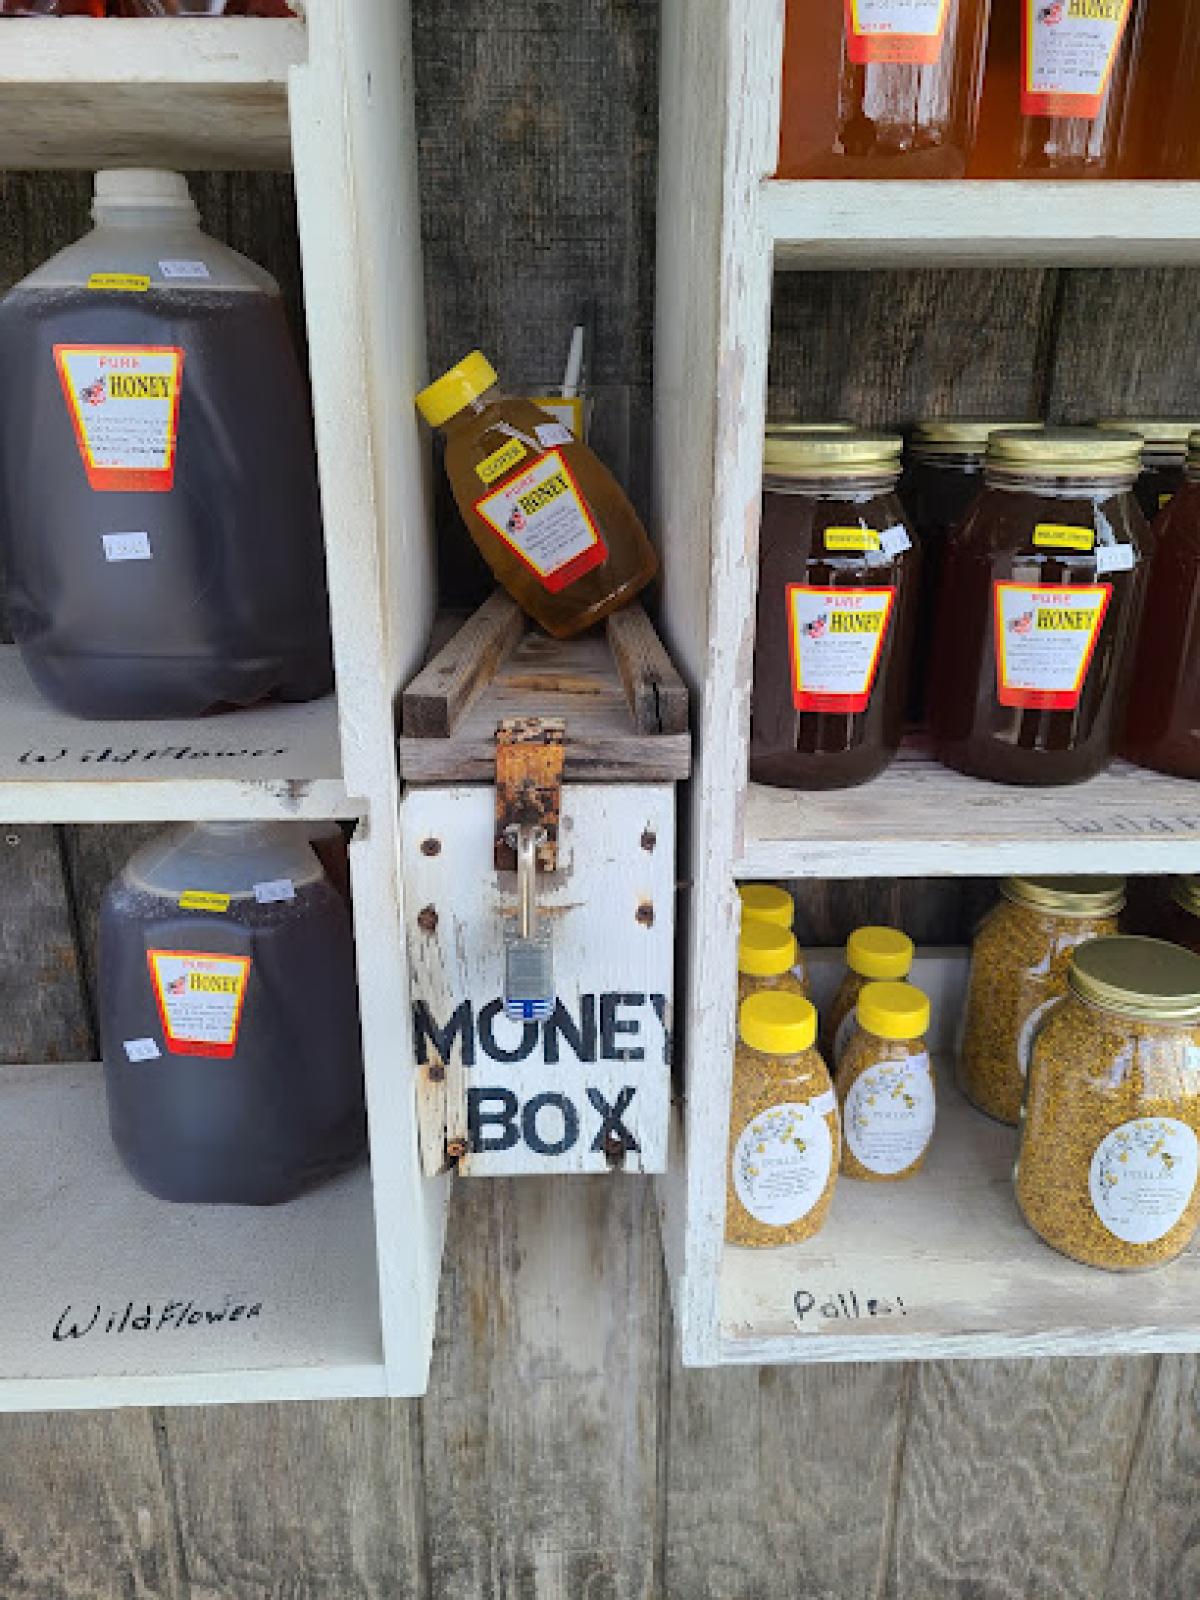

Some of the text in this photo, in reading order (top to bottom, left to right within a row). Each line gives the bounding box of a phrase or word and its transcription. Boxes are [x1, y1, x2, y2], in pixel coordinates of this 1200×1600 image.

[110, 375, 171, 398] HONEY
[519, 473, 569, 514] HONEY
[830, 612, 881, 633] HONEY
[1037, 608, 1095, 630] HONEY
[190, 973, 240, 993] HONEY
[467, 1086, 642, 1156] BOX
